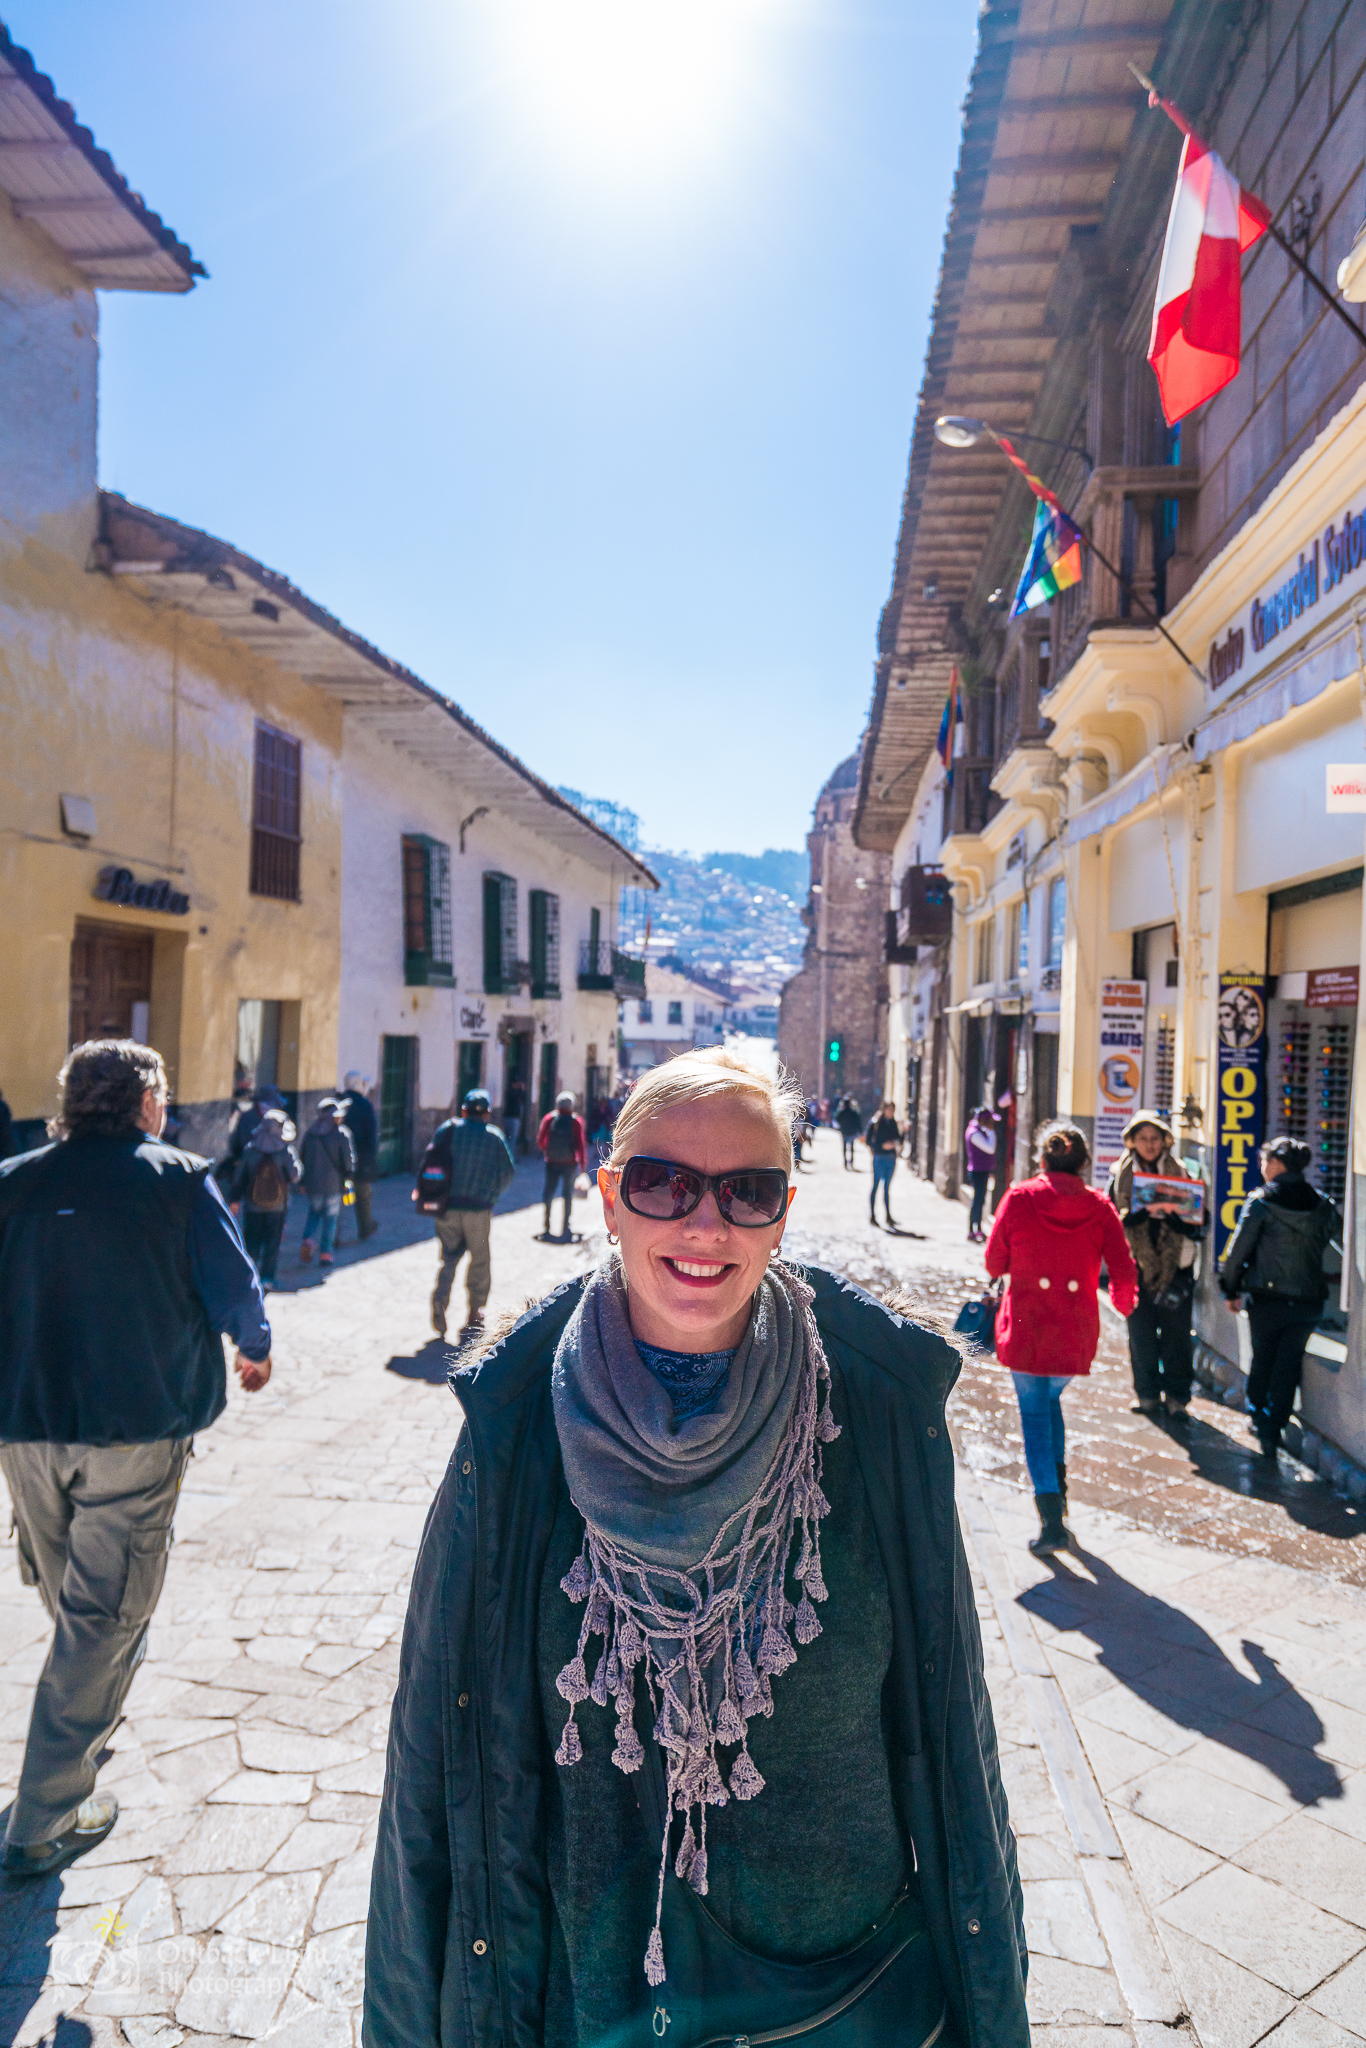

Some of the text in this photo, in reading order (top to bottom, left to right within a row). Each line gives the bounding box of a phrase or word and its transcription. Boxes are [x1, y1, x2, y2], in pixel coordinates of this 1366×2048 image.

[98, 866, 190, 918] Bata
[1221, 976, 1264, 986] IMPERIAL
[1101, 1031, 1143, 1047] GRATIS
[1218, 1066, 1258, 1262] OPTIC
